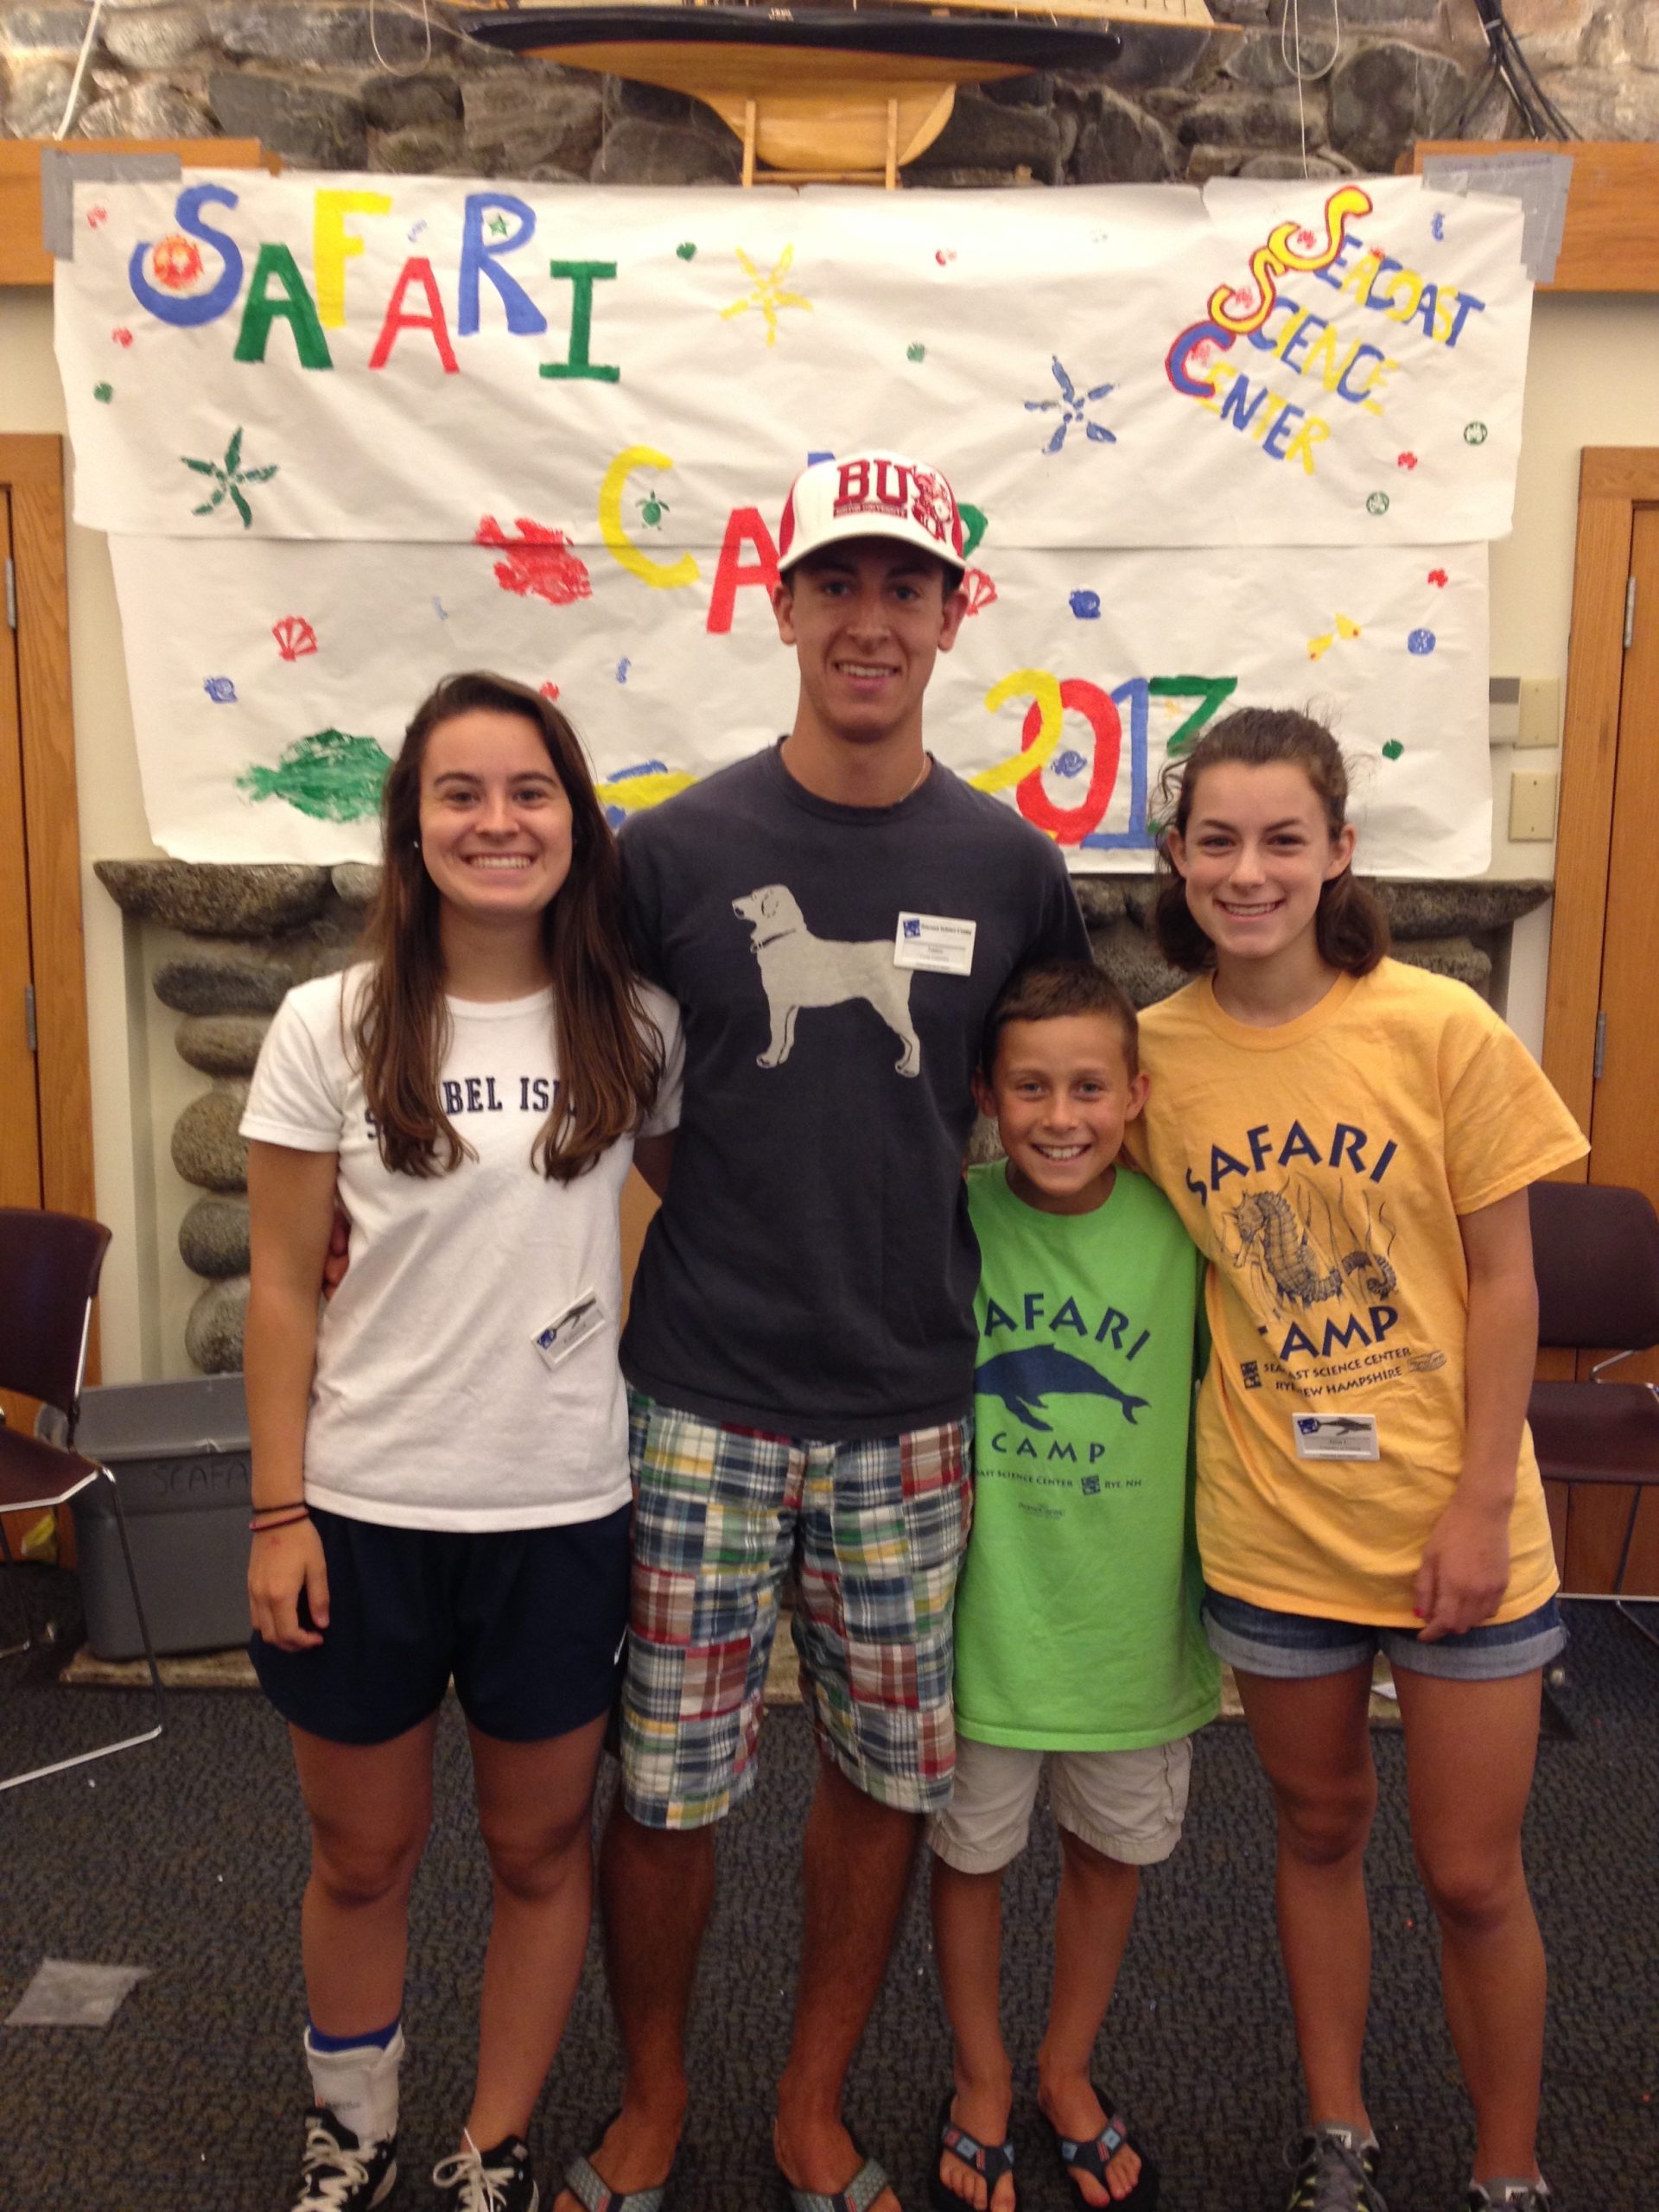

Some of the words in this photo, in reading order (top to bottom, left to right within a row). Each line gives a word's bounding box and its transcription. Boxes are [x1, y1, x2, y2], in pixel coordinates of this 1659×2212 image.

[129, 183, 620, 382] SAFARI
[1268, 185, 1485, 347] SEACOAST
[1207, 245, 1399, 416] SCIENCE
[1165, 320, 1331, 474] CENTER
[834, 459, 908, 506] BU
[1186, 1119, 1397, 1206] SAFARI
[983, 1293, 1151, 1362] AFARI
[1258, 1306, 1399, 1362] AMP
[1313, 1361, 1362, 1377] SCIENCE
[1364, 1346, 1411, 1366] CENTER
[1326, 1366, 1403, 1395] HAMPSHIRE
[991, 1432, 1106, 1464] CAMP
